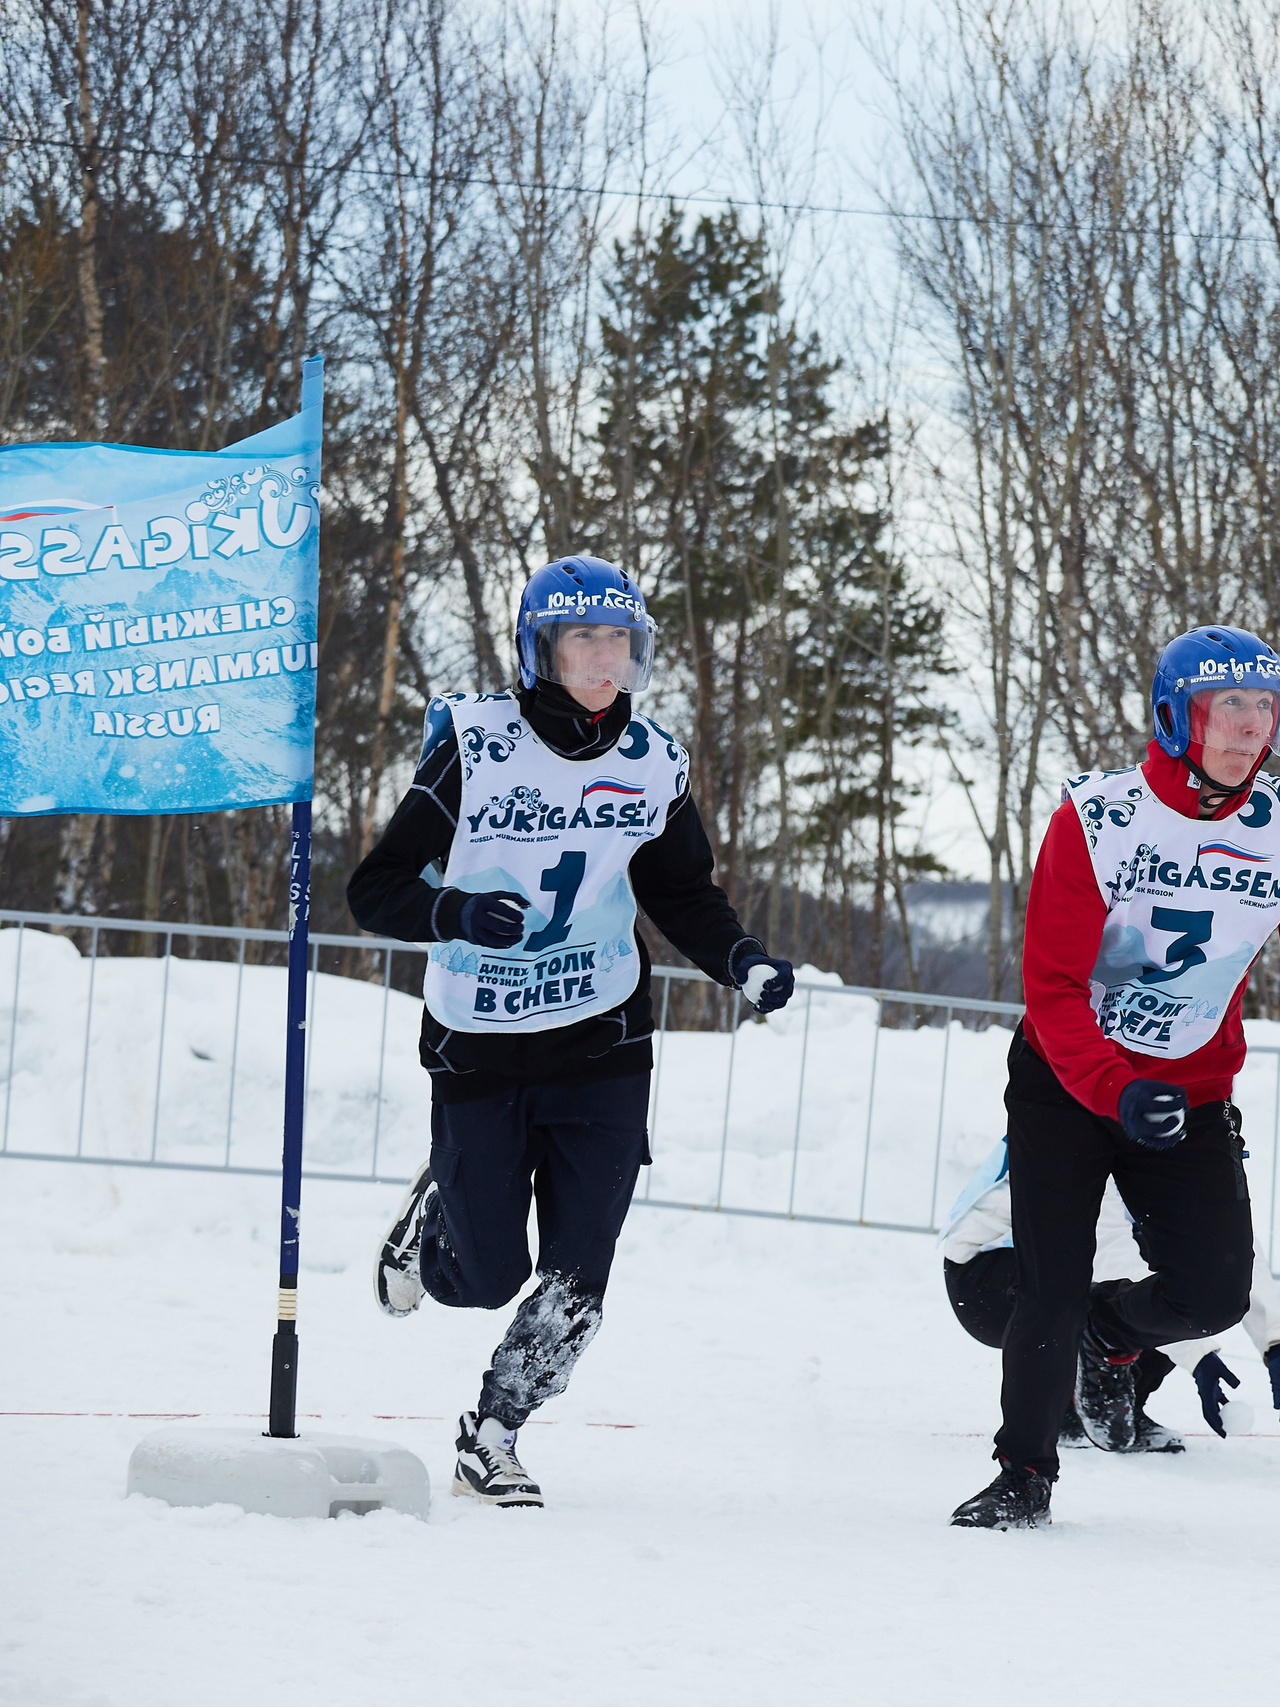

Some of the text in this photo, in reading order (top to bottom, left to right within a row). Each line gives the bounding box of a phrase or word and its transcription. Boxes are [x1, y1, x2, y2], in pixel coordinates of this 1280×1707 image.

[495, 833, 535, 843] MURMANSK
[536, 834, 559, 843] REGION
[523, 850, 588, 953] 1
[1146, 888, 1174, 898] REGION
[1140, 905, 1215, 984] 3
[479, 963, 506, 975] ДЛЯ
[533, 950, 596, 980] ТОЛК
[477, 975, 500, 985] КТО
[474, 973, 596, 1015] В СНЕГЕ
[1125, 991, 1188, 1018] ТОЛК
